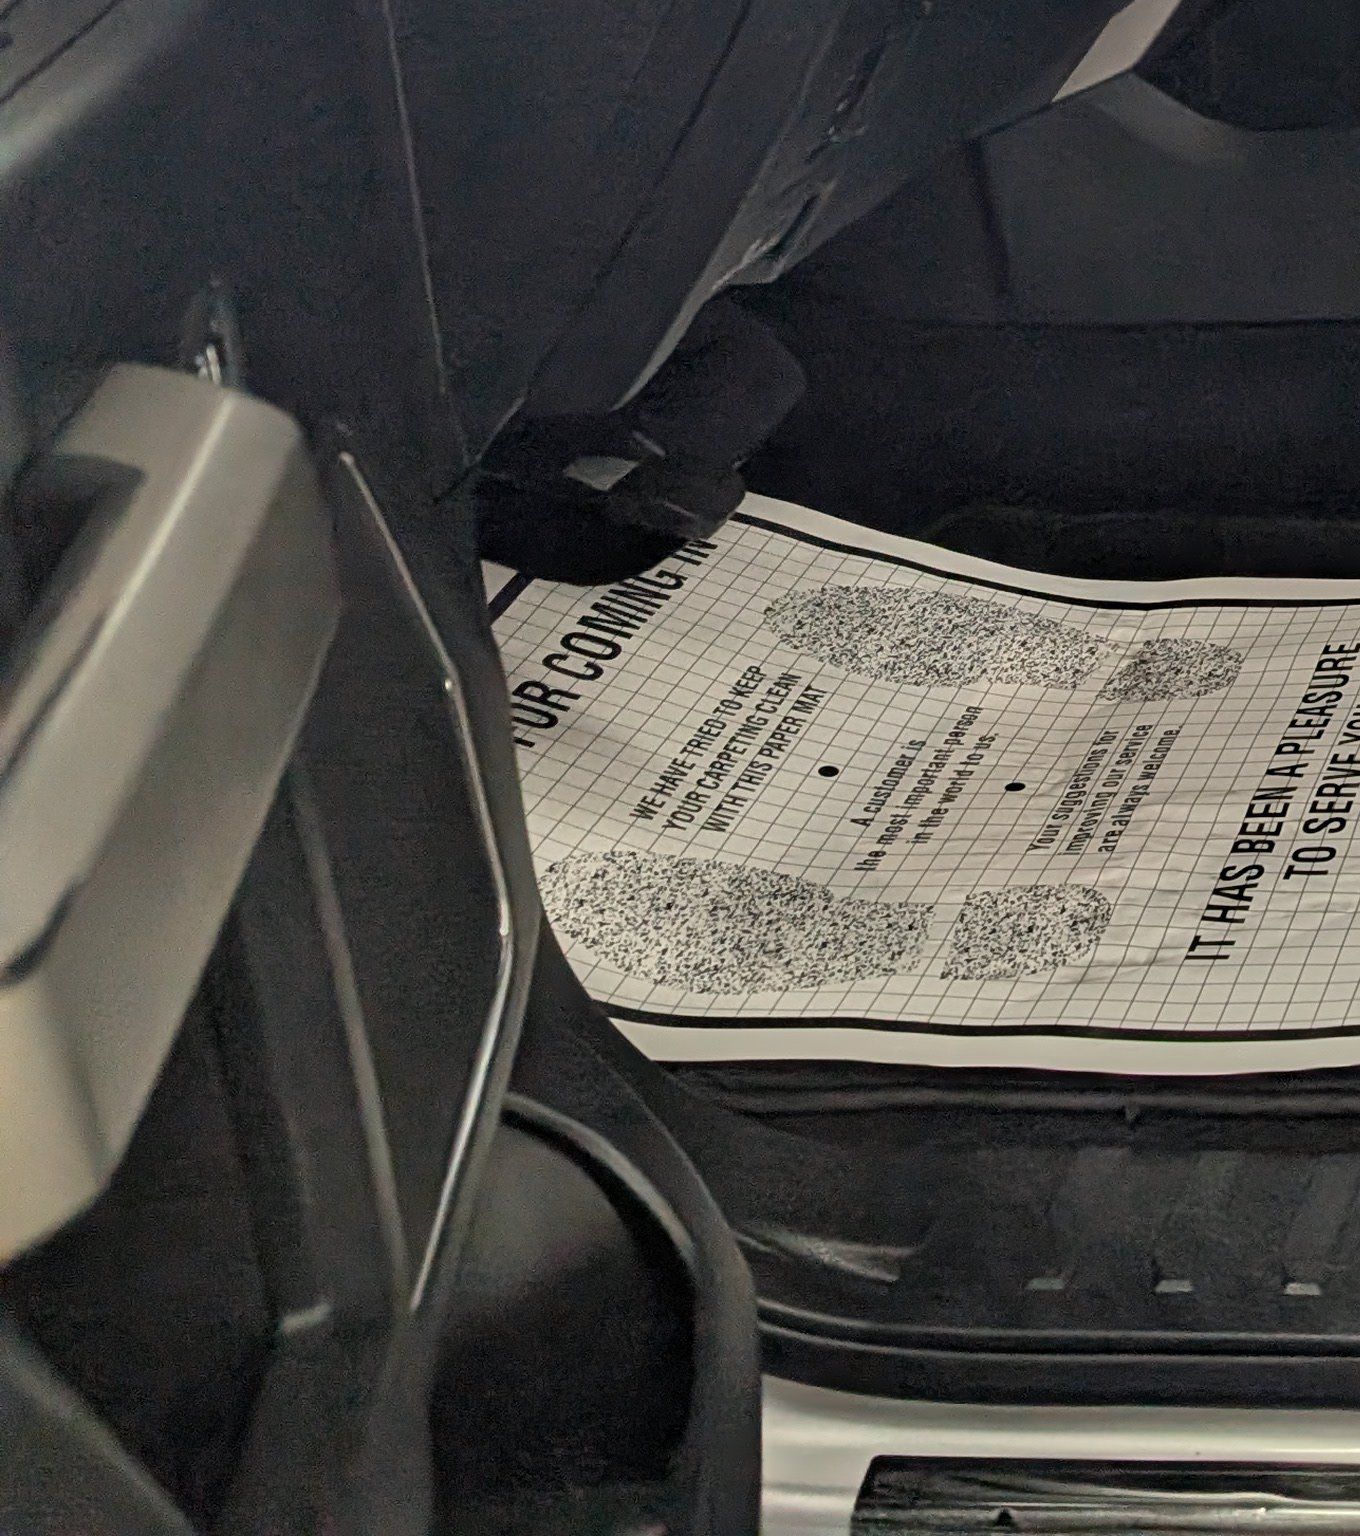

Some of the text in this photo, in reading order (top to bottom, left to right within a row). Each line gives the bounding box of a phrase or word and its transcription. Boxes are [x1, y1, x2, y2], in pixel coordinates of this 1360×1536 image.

[541, 569, 688, 681] COMING
[630, 665, 767, 820] WE HAVE TRIED TO KEEP
[661, 672, 802, 831] YOUR CARPETING CLEAN
[700, 684, 828, 833] WITH THIS PAPER MAT
[850, 739, 927, 827] A customer is
[854, 705, 984, 871] the most important person
[906, 733, 999, 844] in the world to us.
[1027, 730, 1119, 852] Your suggestions for
[1057, 724, 1153, 856] improving our service
[1098, 725, 1183, 852] are always welcome.
[1265, 762, 1309, 778] A
[1230, 785, 1298, 854] BEEN
[1282, 846, 1337, 880] TO
[1184, 934, 1236, 961] IT
[1200, 863, 1265, 924] HAS
